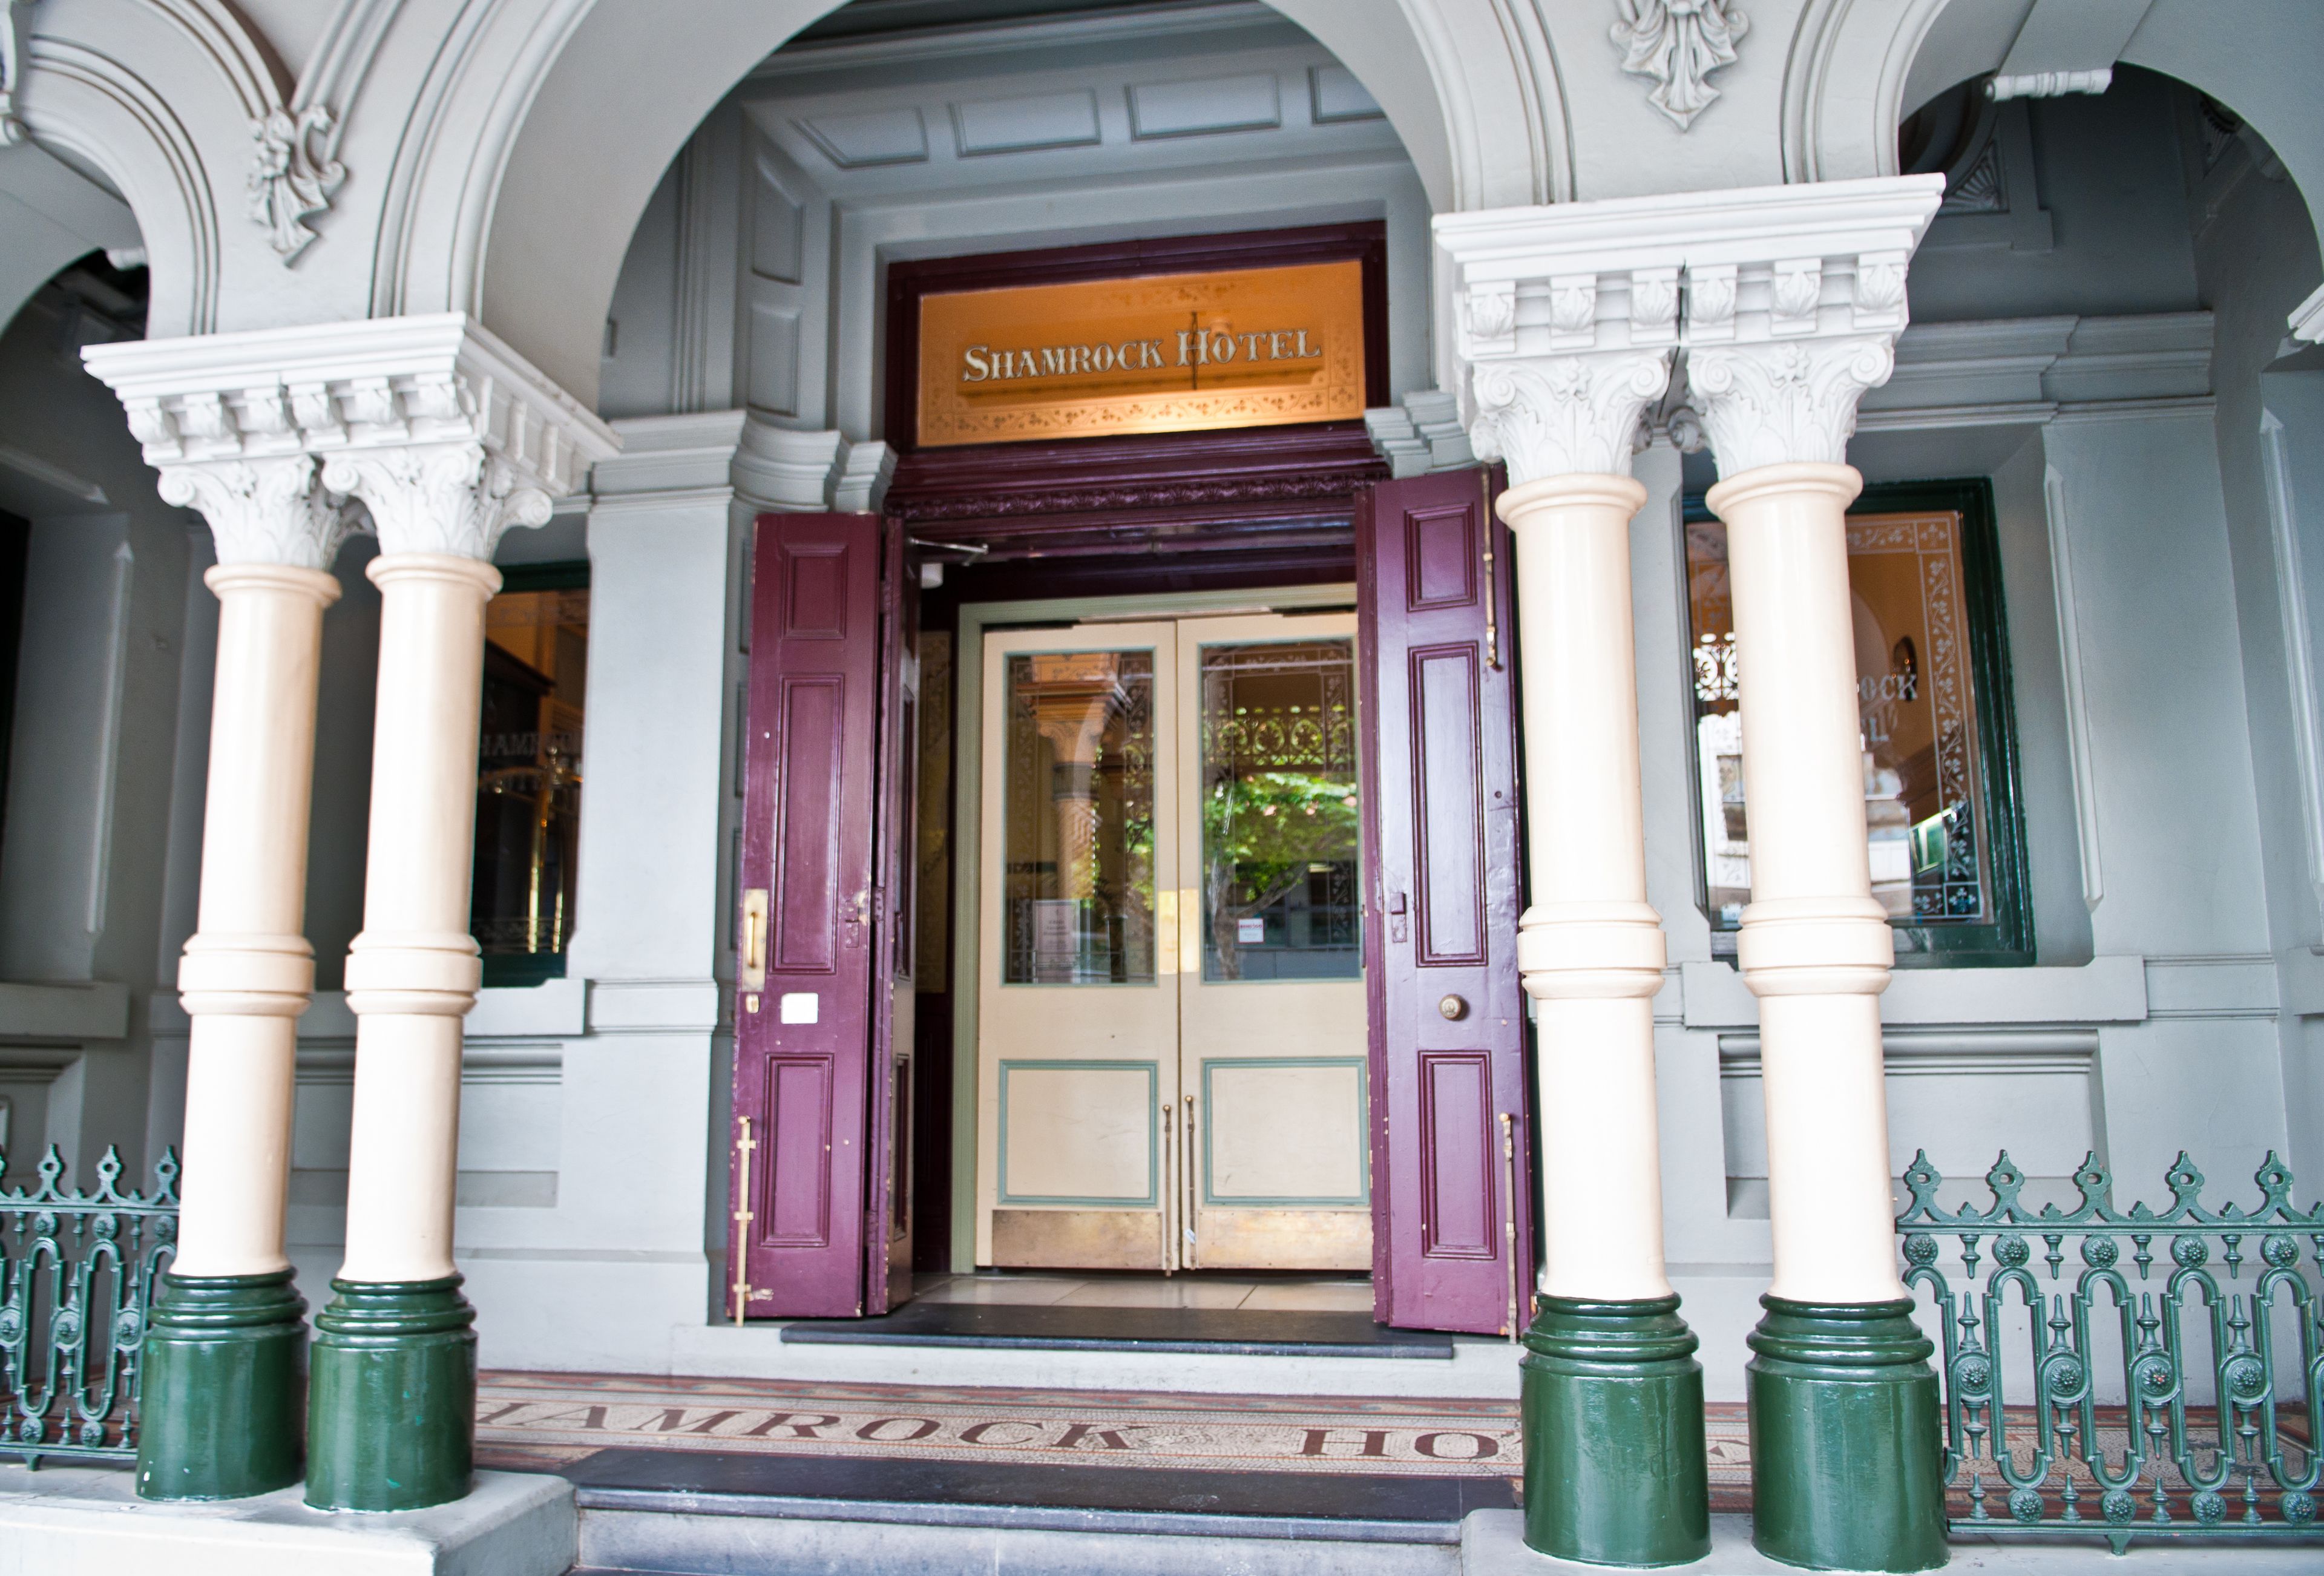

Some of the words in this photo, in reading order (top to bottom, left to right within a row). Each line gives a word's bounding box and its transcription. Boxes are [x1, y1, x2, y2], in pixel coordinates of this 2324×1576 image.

[962, 338, 1165, 382] SHAMROCK
[1175, 327, 1322, 367] HOTEL
[1859, 674, 1918, 701] OCK
[1296, 1429, 1522, 1459] HO
